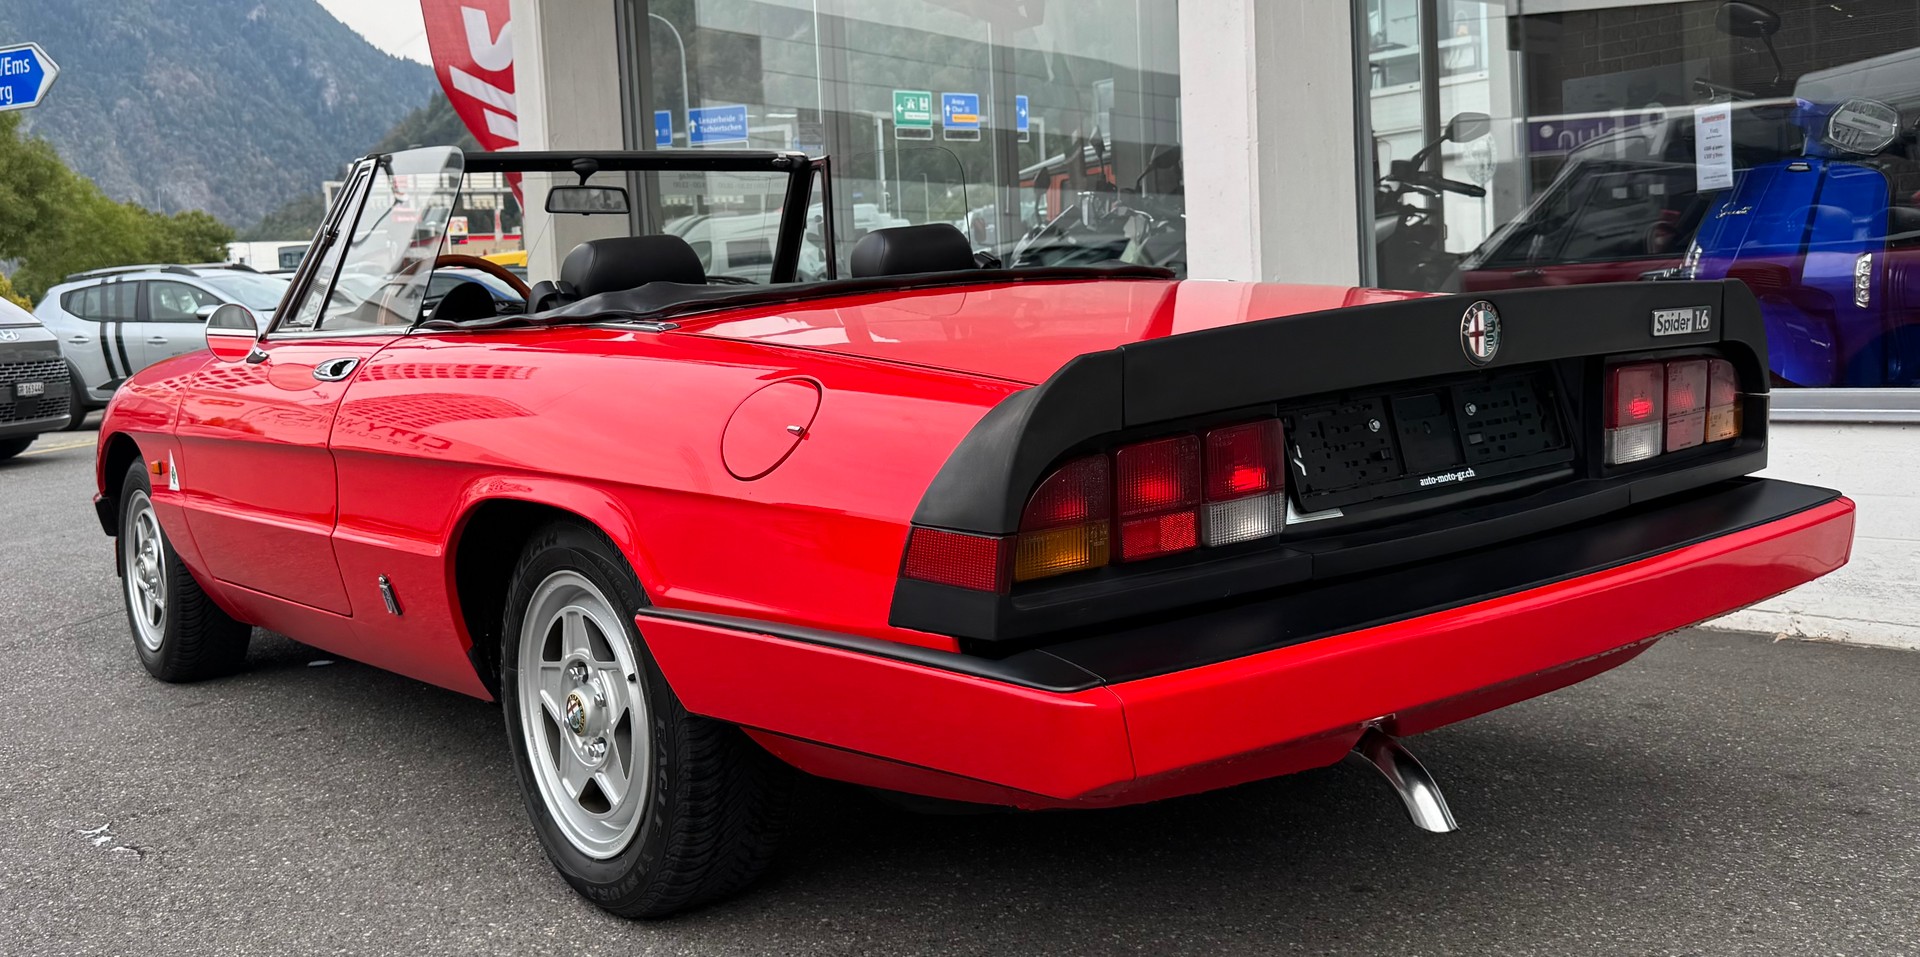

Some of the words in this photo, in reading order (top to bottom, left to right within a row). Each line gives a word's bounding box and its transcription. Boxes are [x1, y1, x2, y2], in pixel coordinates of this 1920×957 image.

[1656, 312, 1691, 335] Spider
[1695, 309, 1709, 330] 1.6
[1419, 467, 1476, 486] auto-moto-gr.ch
